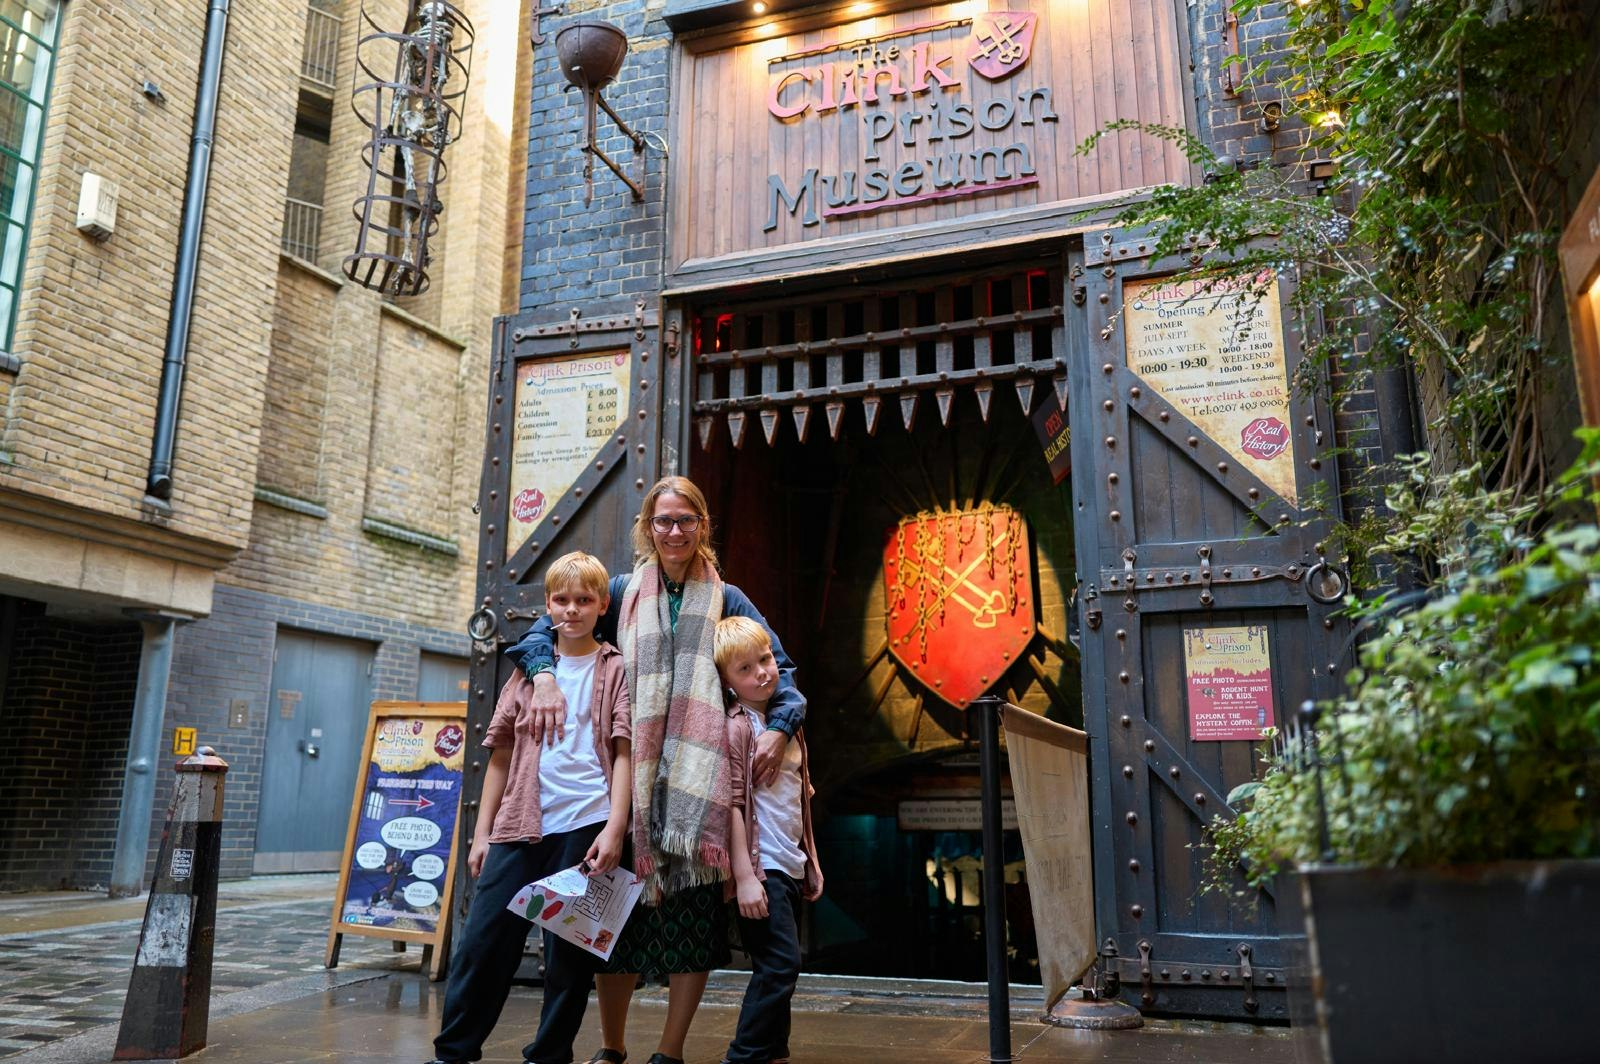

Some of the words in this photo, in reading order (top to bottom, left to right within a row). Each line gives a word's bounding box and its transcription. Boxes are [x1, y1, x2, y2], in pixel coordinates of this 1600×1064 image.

[852, 43, 900, 68] The
[767, 41, 961, 119] Clink
[763, 142, 1038, 233] Museum
[1158, 306, 1205, 318] Opening
[1143, 321, 1183, 332] SUMMER
[1253, 332, 1268, 341] FRI
[1138, 346, 1165, 358] DAYS
[1176, 342, 1207, 353] WEEK
[1250, 342, 1273, 351] 18:00
[1222, 352, 1270, 364] WEEKEND
[1140, 362, 1168, 374] 10:00
[1180, 356, 1208, 369] 19:30
[1220, 365, 1242, 374] 10:00
[520, 400, 542, 408] Adults
[598, 388, 618, 396] 8.00
[518, 410, 550, 418] Children
[598, 402, 617, 410] 6.00
[1240, 401, 1258, 411] 403
[517, 420, 558, 430] Concession
[598, 415, 616, 423] 6.00
[1246, 420, 1285, 436] Real
[177, 730, 194, 752] H
[434, 780, 454, 790] WAY
[390, 822, 408, 830] FREE
[410, 822, 432, 832] PHOTO
[387, 832, 412, 840] BEHIND
